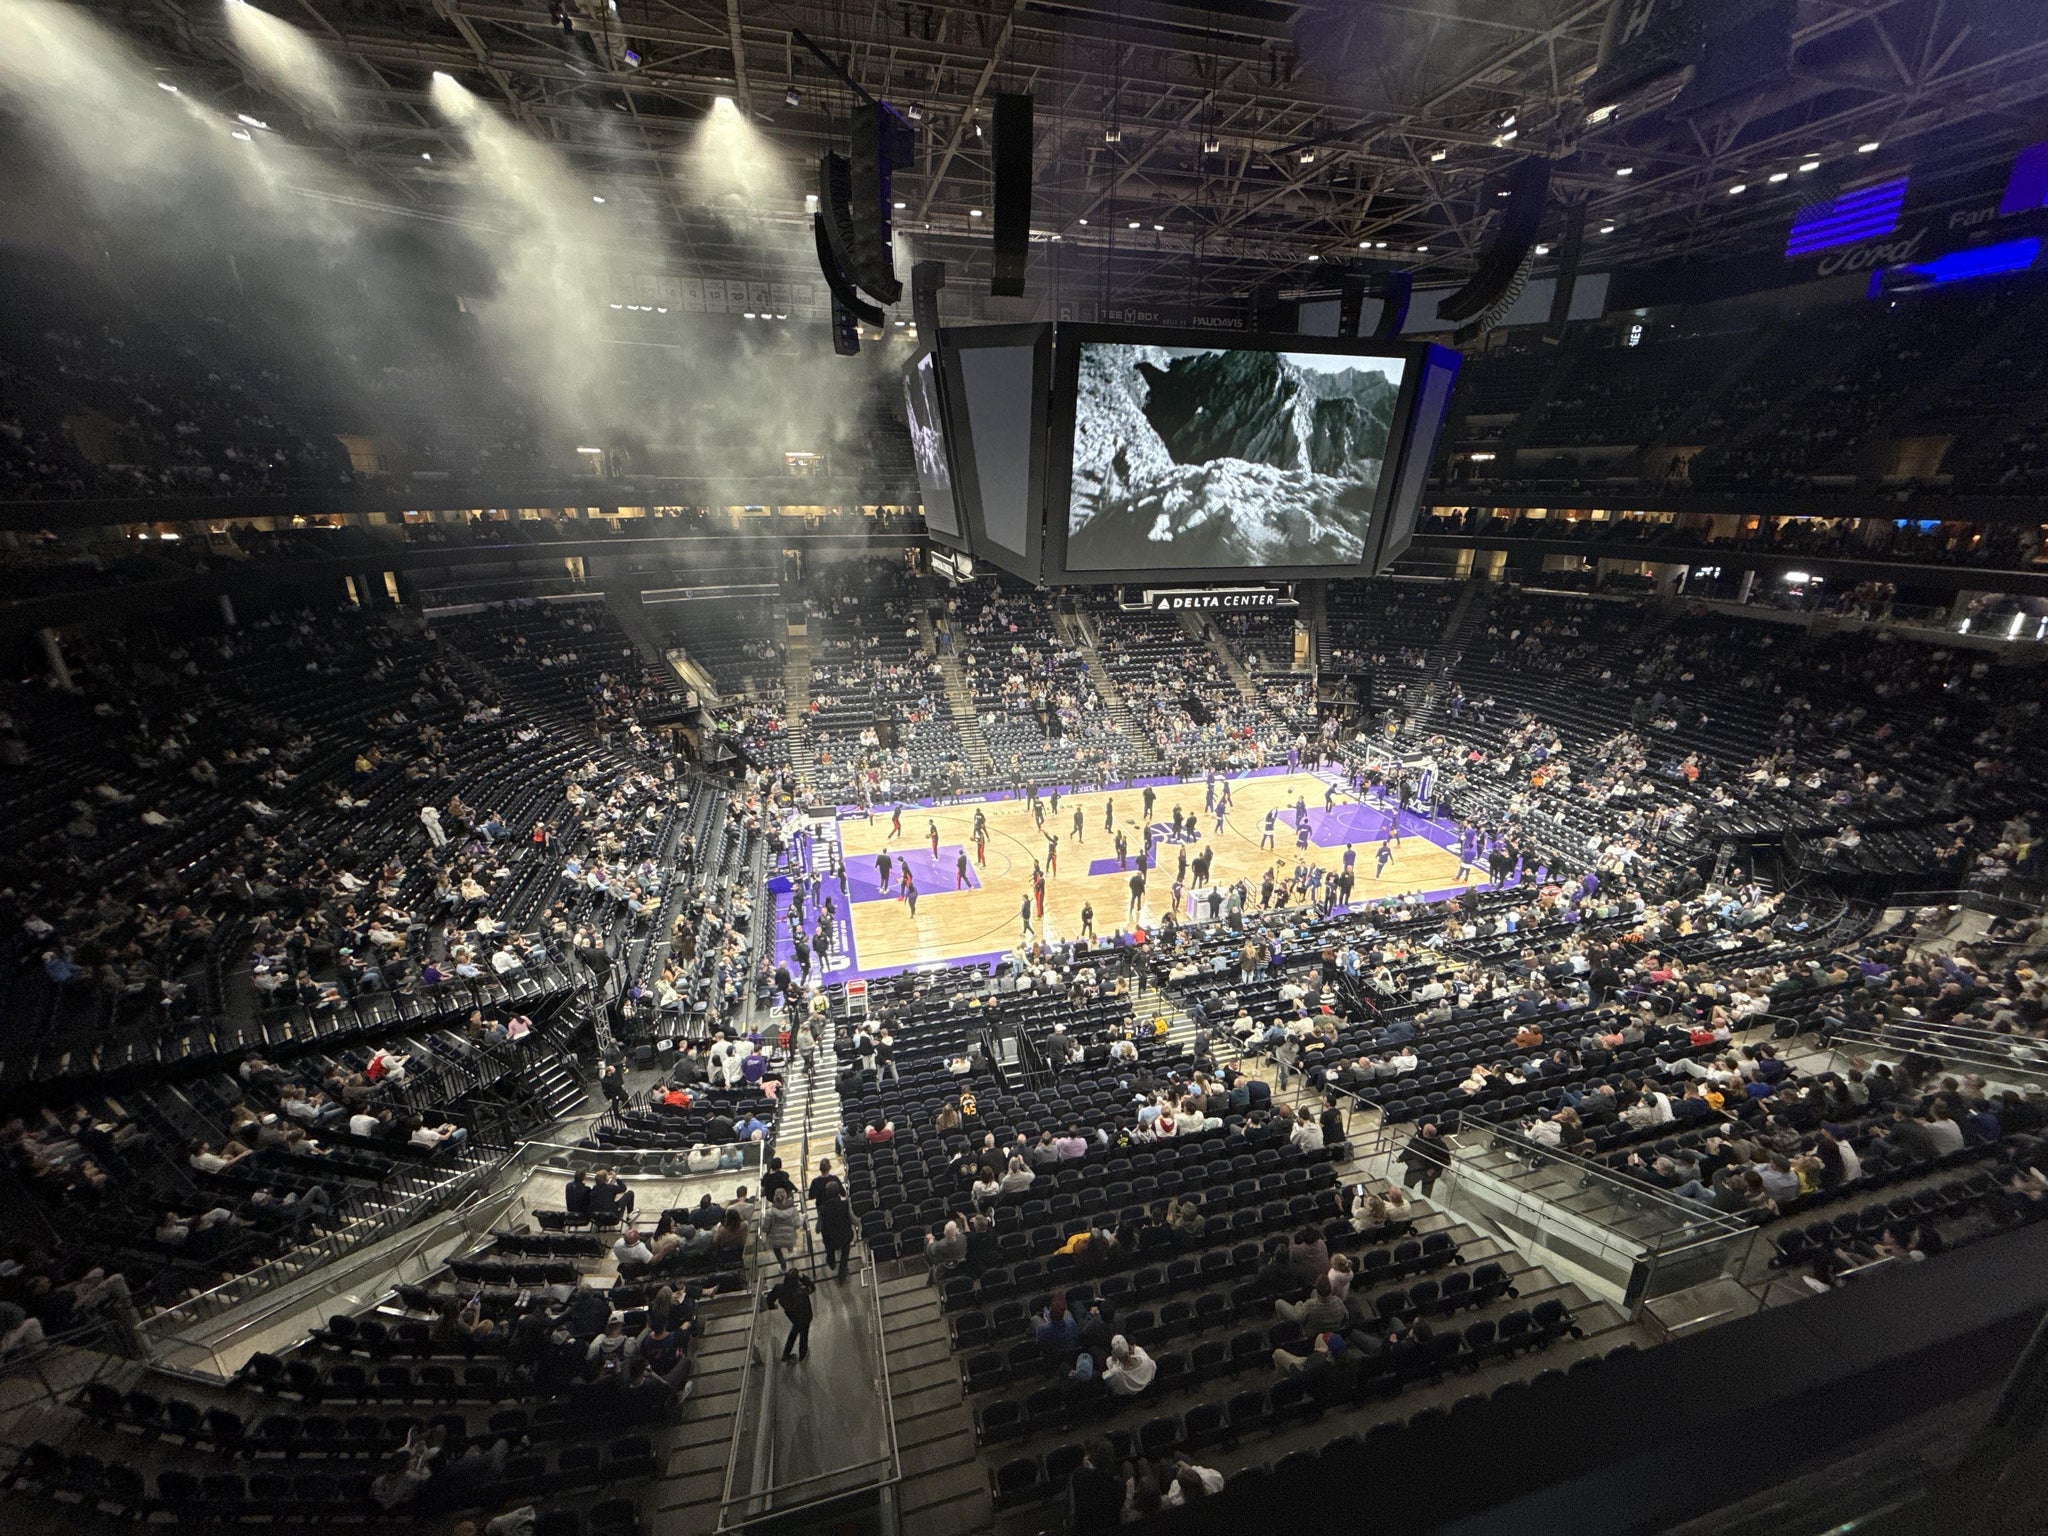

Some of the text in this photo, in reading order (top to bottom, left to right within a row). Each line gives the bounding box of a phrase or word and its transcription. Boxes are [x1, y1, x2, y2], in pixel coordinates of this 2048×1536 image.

[1949, 206, 1995, 228] Fan
[1817, 227, 1928, 276] Ford
[1101, 309, 1123, 320] TEE
[1137, 312, 1159, 322] BOX
[1173, 595, 1274, 608] DELTA CENTER
[963, 1104, 977, 1115] 45
